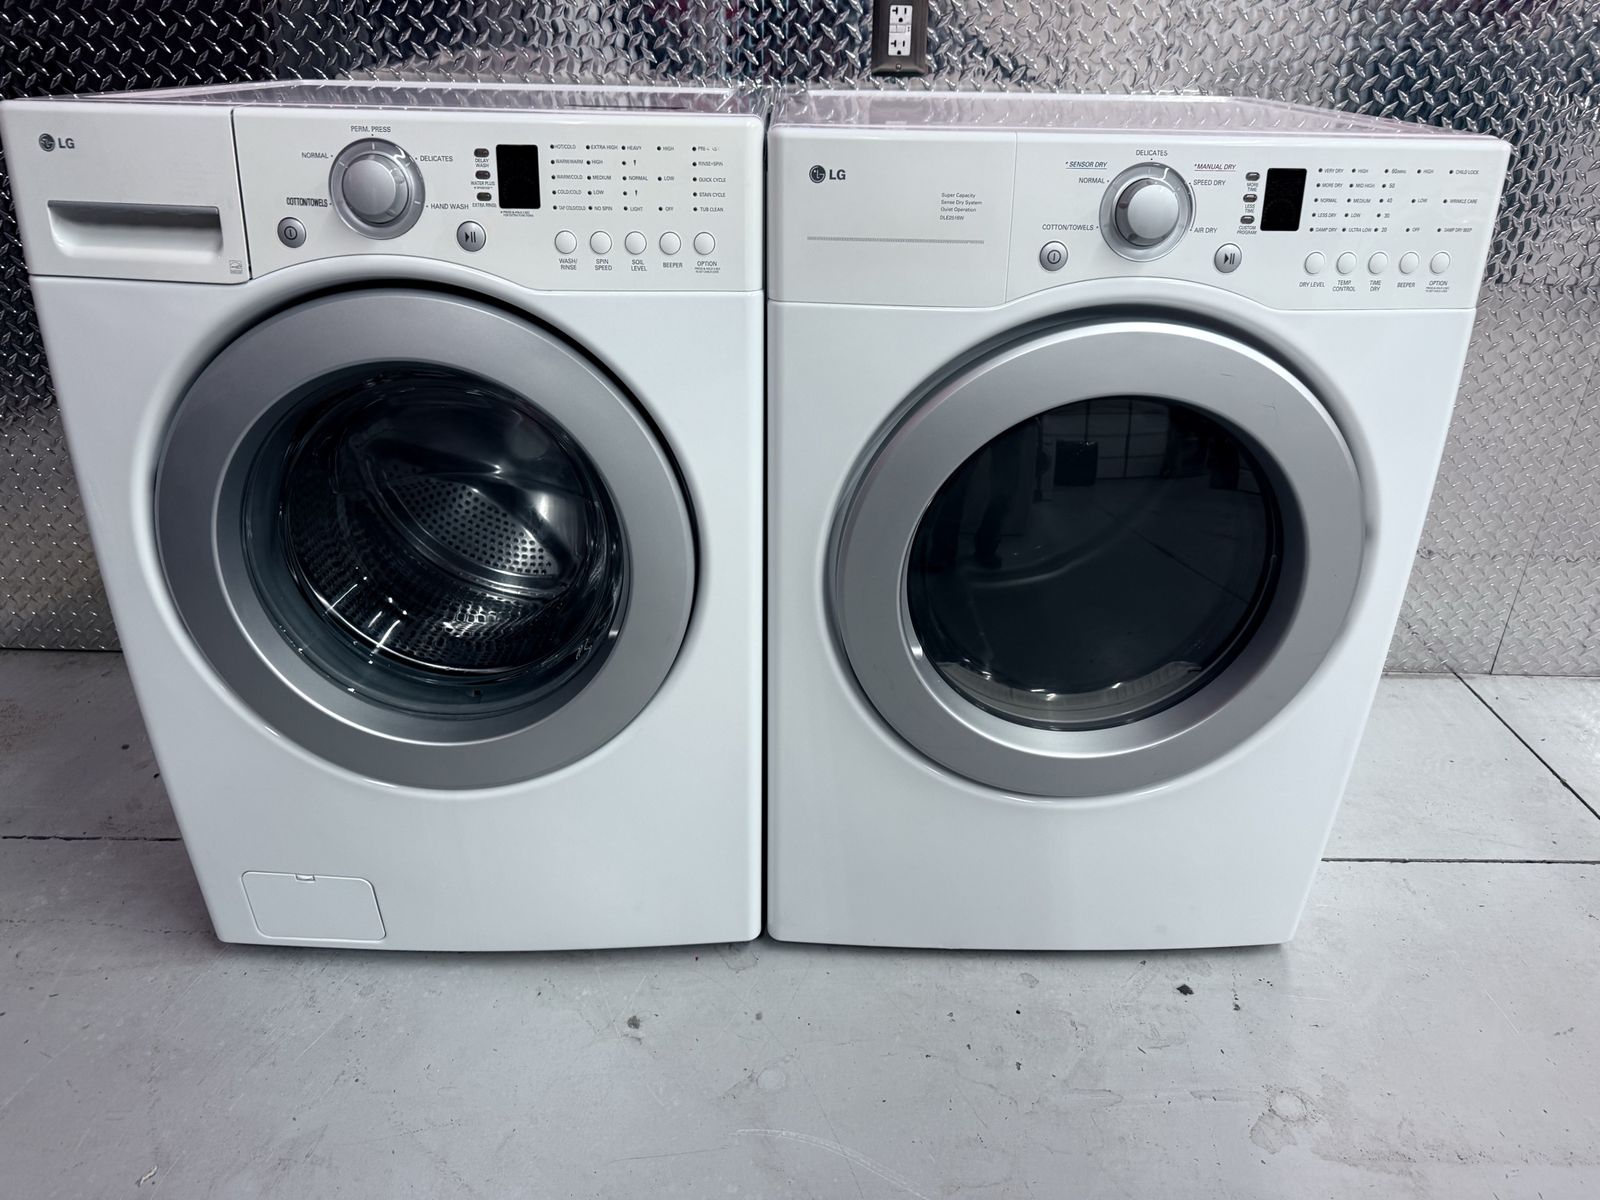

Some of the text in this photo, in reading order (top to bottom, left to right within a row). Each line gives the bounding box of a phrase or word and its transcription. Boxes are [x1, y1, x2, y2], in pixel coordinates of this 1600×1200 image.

[350, 125, 370, 133] PERM.
[58, 138, 75, 149] LG
[1135, 149, 1168, 157] DELICATES
[829, 169, 846, 181] LG
[430, 202, 469, 210] HAND WASH
[1042, 223, 1094, 231] COTTON/TOWELS
